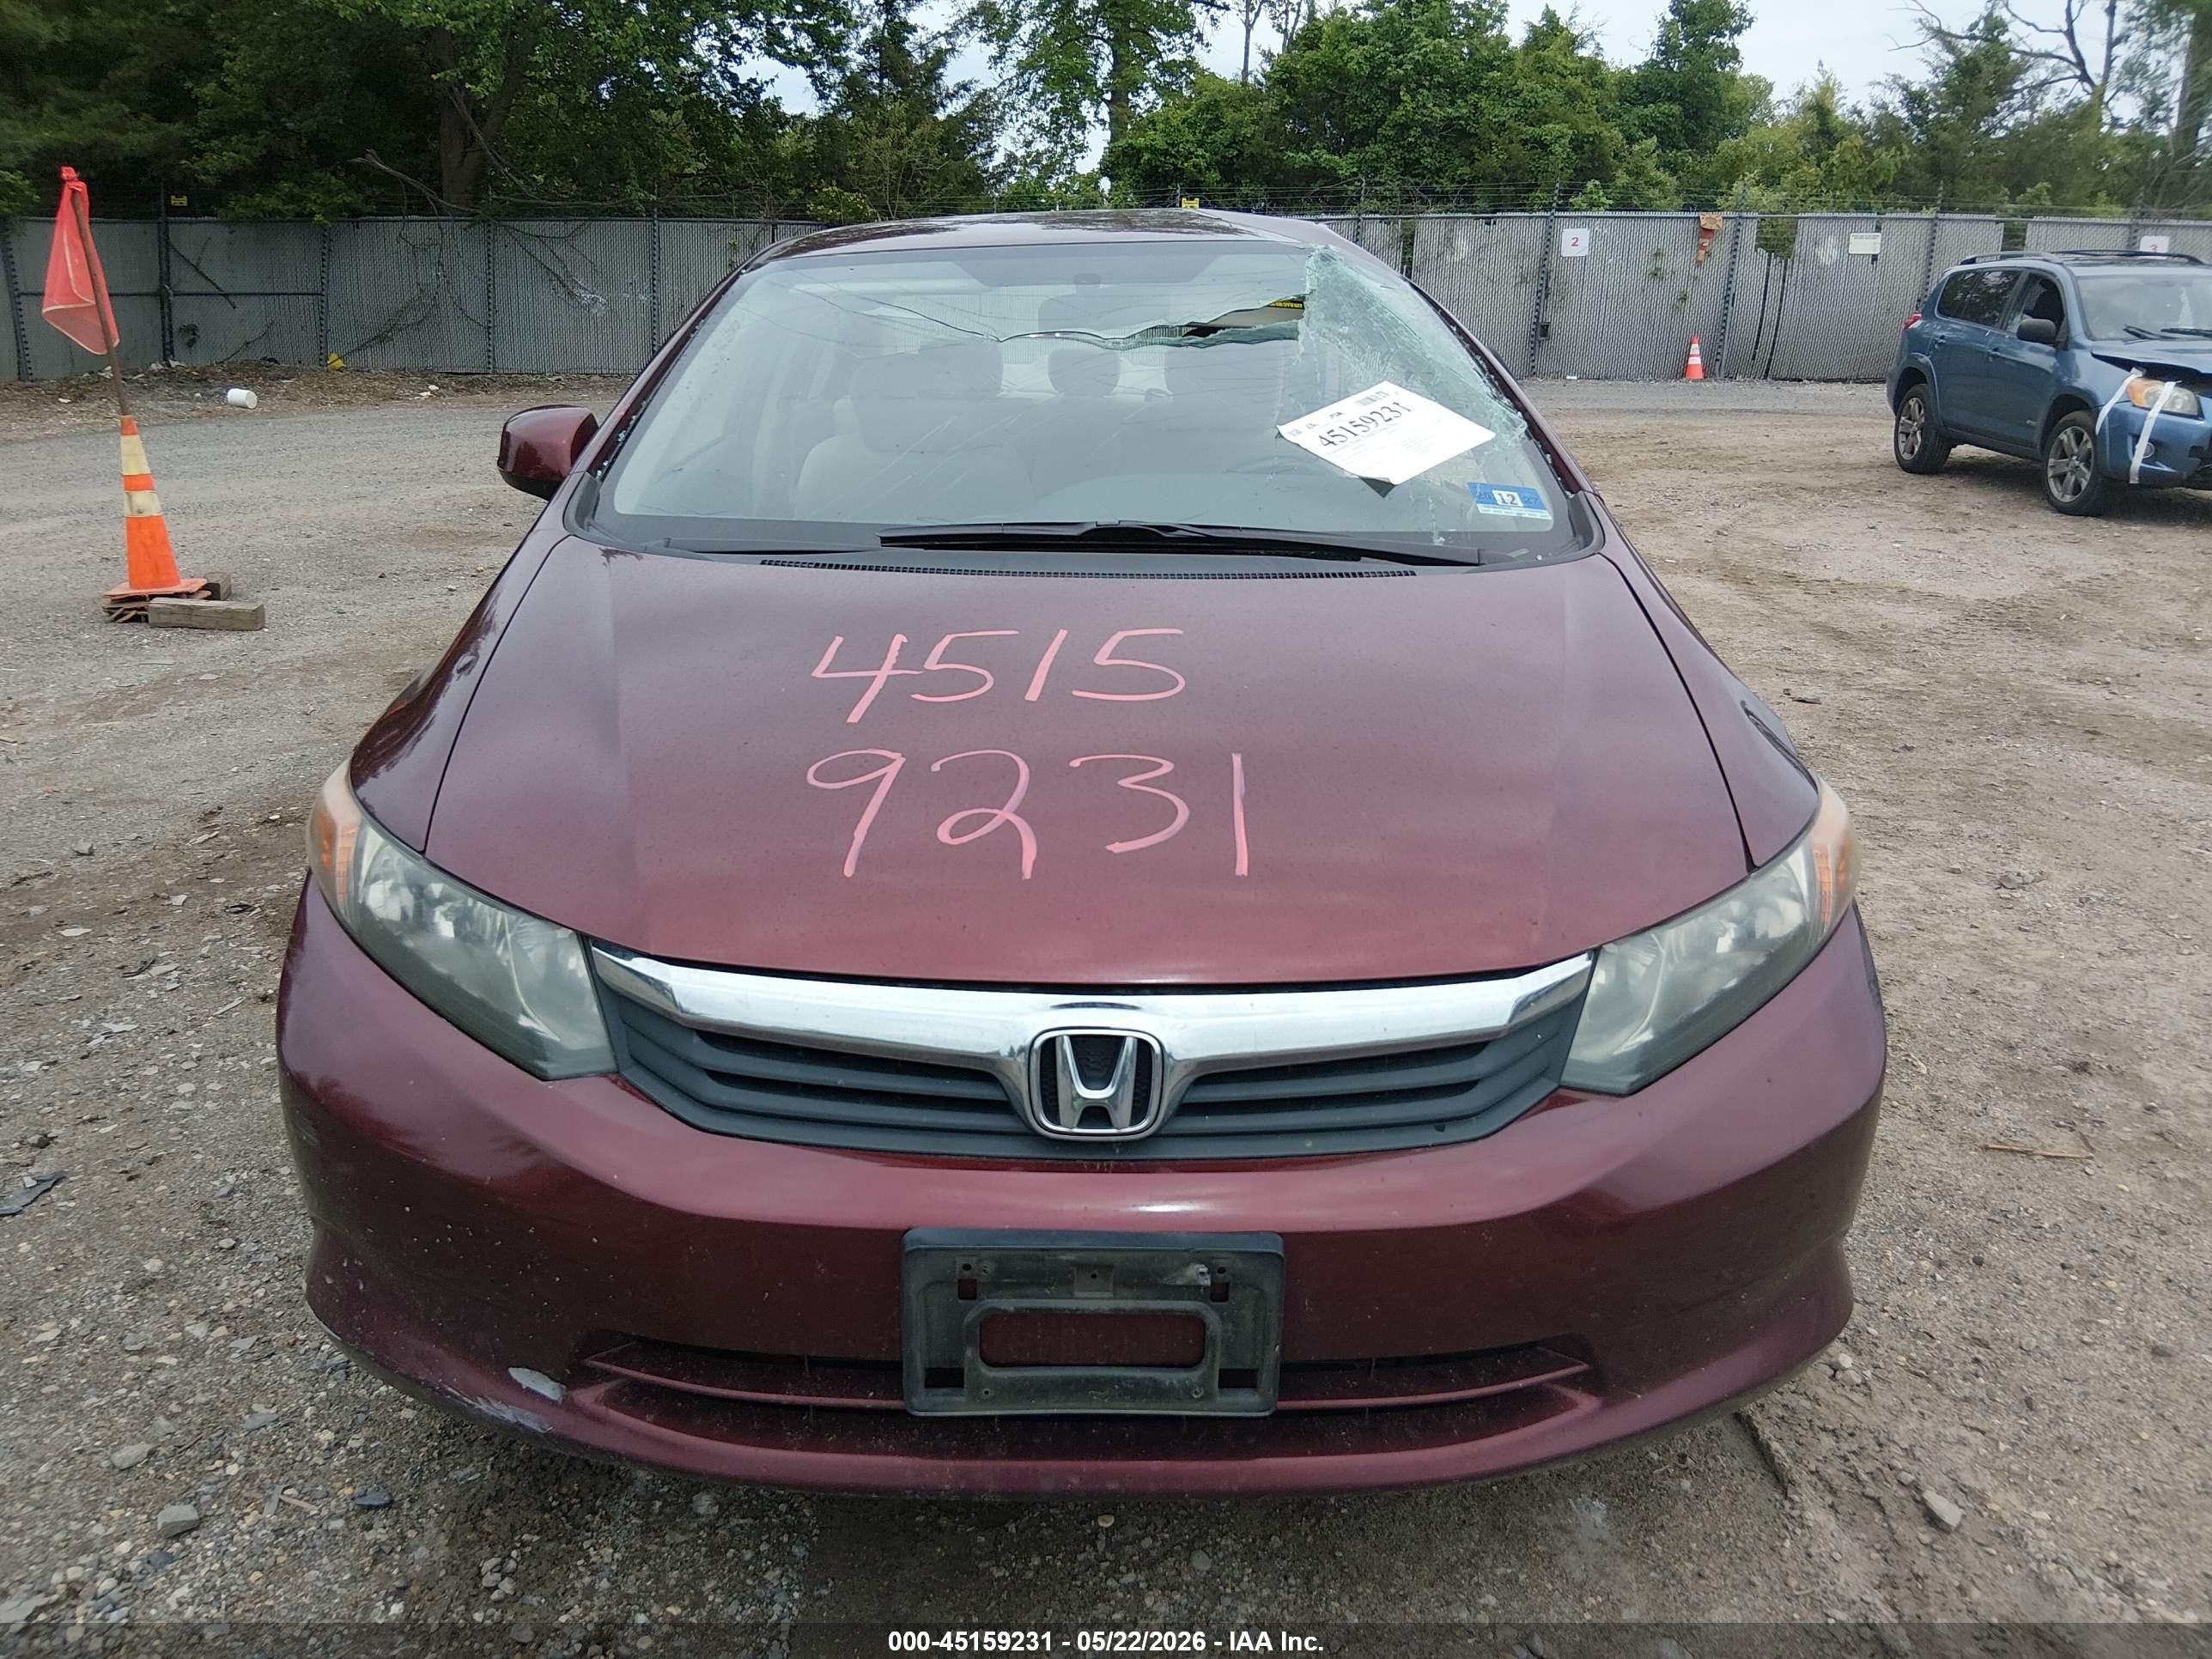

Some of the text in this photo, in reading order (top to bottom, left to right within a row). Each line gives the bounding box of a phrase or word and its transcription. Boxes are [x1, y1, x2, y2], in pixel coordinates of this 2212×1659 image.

[1571, 236, 1579, 247] 2
[1318, 401, 1412, 447] 45159231
[1497, 492, 1519, 506] 12
[811, 629, 1187, 724] 4515
[806, 748, 1249, 880] 9231
